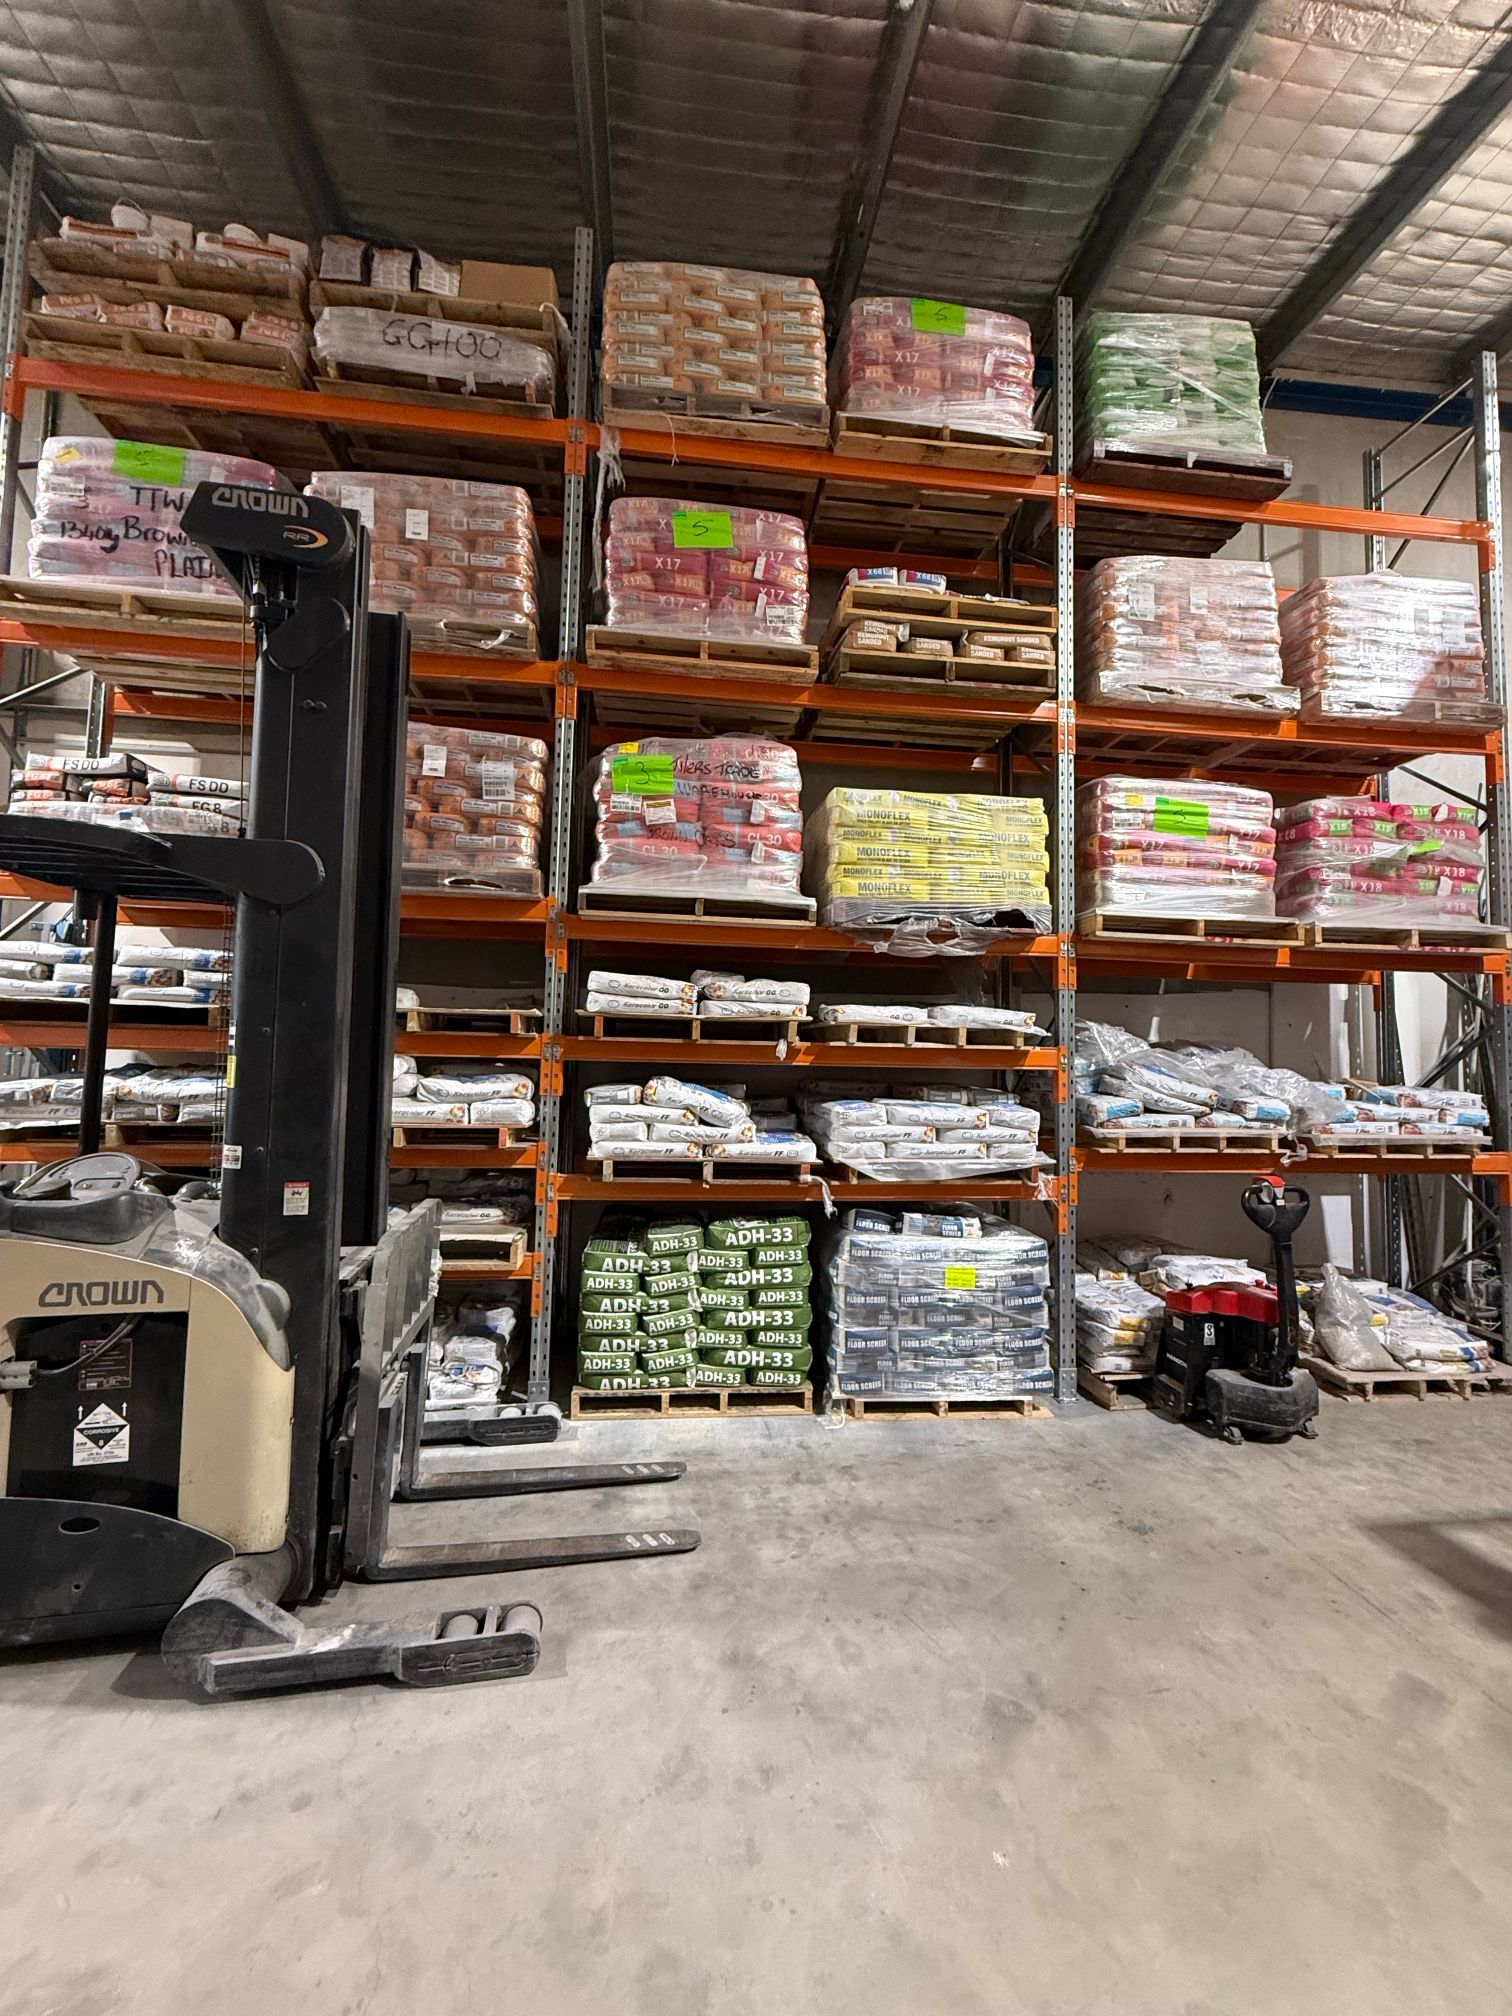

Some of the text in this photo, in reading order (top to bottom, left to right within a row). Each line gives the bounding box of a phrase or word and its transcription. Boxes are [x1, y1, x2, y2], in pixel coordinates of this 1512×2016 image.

[934, 306, 953, 321] 5
[895, 351, 920, 363] X17
[897, 384, 920, 397] X17
[211, 486, 310, 518] CROWN
[692, 519, 715, 536] 5
[655, 557, 681, 570] X17
[635, 761, 650, 785] 3
[857, 810, 911, 821] MONOFLEX
[843, 829, 882, 838] MONOFLEX
[766, 835, 782, 846] 30
[857, 847, 911, 857] MONOFLEX
[1007, 852, 1043, 861] MONOFLEX
[843, 868, 883, 876] MONOFLEX
[1444, 866, 1466, 876] X18
[858, 882, 912, 893] MONOFLEX
[1361, 882, 1382, 891] X18
[1007, 889, 1043, 898] MONOFLEX
[725, 1228, 793, 1246] ADH-33
[652, 1237, 698, 1251] ADH-33
[758, 1250, 802, 1261] ADH-33
[851, 1249, 870, 1257] FLOOR
[602, 1258, 671, 1273] ADH-33
[699, 1255, 743, 1268] ADH-33
[725, 1268, 793, 1285] ADH-33
[587, 1277, 633, 1289] ADH-33
[651, 1276, 696, 1292] ADH-33
[38, 1280, 164, 1307] CROWN
[700, 1293, 744, 1306] ADH-33
[759, 1291, 803, 1302] ADH-33
[600, 1299, 670, 1312] ADH-33
[901, 1296, 919, 1304] FLOOR
[1005, 1297, 1023, 1307] FLOOR
[585, 1318, 631, 1329] ADH-33
[649, 1314, 694, 1332] ADH-33
[725, 1311, 793, 1326] ADH-33
[698, 1332, 743, 1344] ADH-33
[758, 1332, 802, 1343] ADH-33
[599, 1339, 669, 1352] ADH-33
[848, 1340, 865, 1348] FLOOR
[584, 1358, 630, 1369] ADH-33
[648, 1354, 693, 1370] ADH-33
[724, 1351, 793, 1367] ADH-33
[600, 1377, 670, 1389] ADH-33
[697, 1371, 741, 1383] ADH-33
[756, 1372, 801, 1384] ADH-33
[83, 1427, 120, 1436] CORROSIVE
